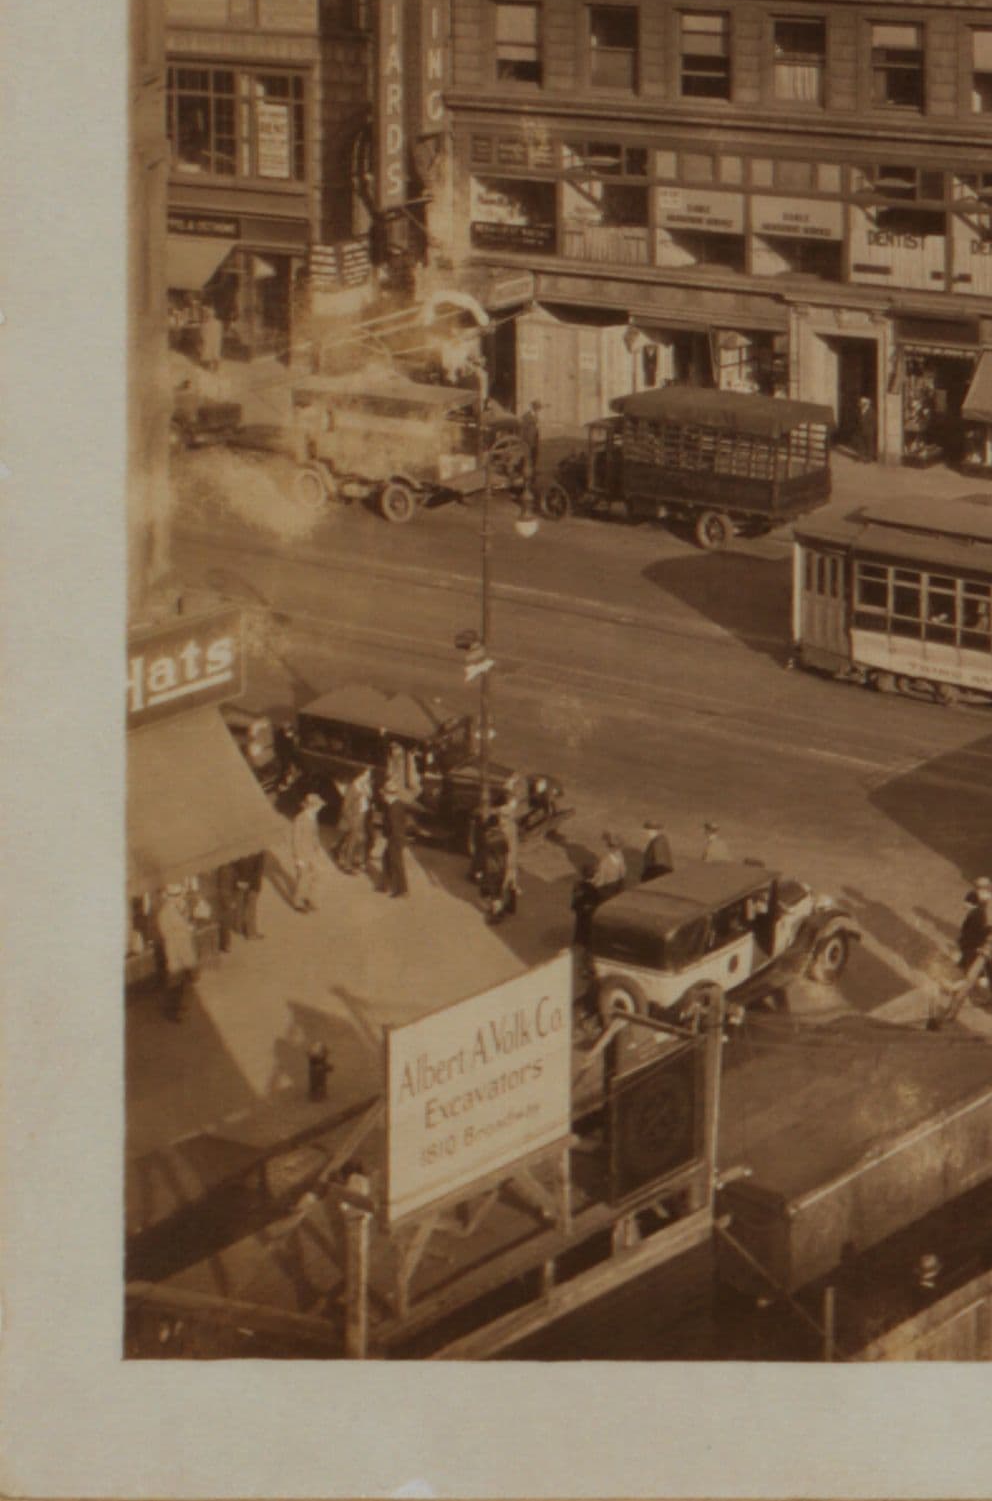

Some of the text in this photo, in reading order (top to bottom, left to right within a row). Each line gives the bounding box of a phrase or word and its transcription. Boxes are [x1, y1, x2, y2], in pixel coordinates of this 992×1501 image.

[867, 229, 925, 251] DENTIST
[399, 1047, 465, 1104] Albert
[424, 1057, 544, 1131] Excavators
